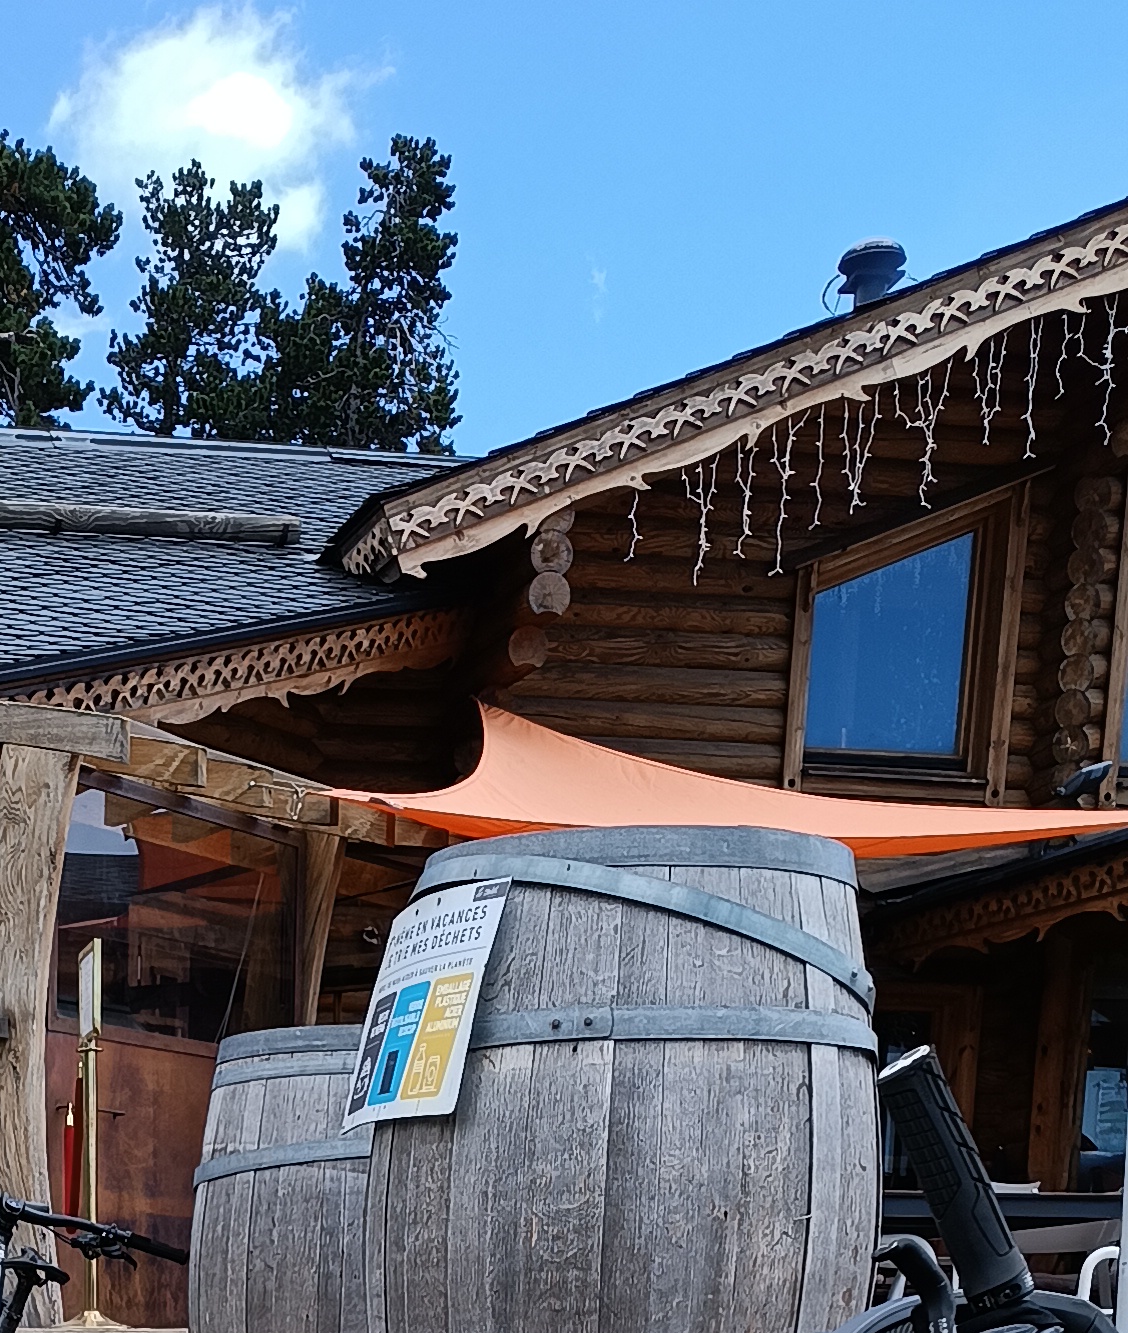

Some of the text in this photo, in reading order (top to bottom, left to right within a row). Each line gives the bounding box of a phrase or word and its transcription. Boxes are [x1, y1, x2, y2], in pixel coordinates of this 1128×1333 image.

[415, 919, 429, 938] EN
[430, 904, 488, 931] VACANCES
[410, 937, 429, 957] MES
[430, 925, 483, 950] DÉCHETS
